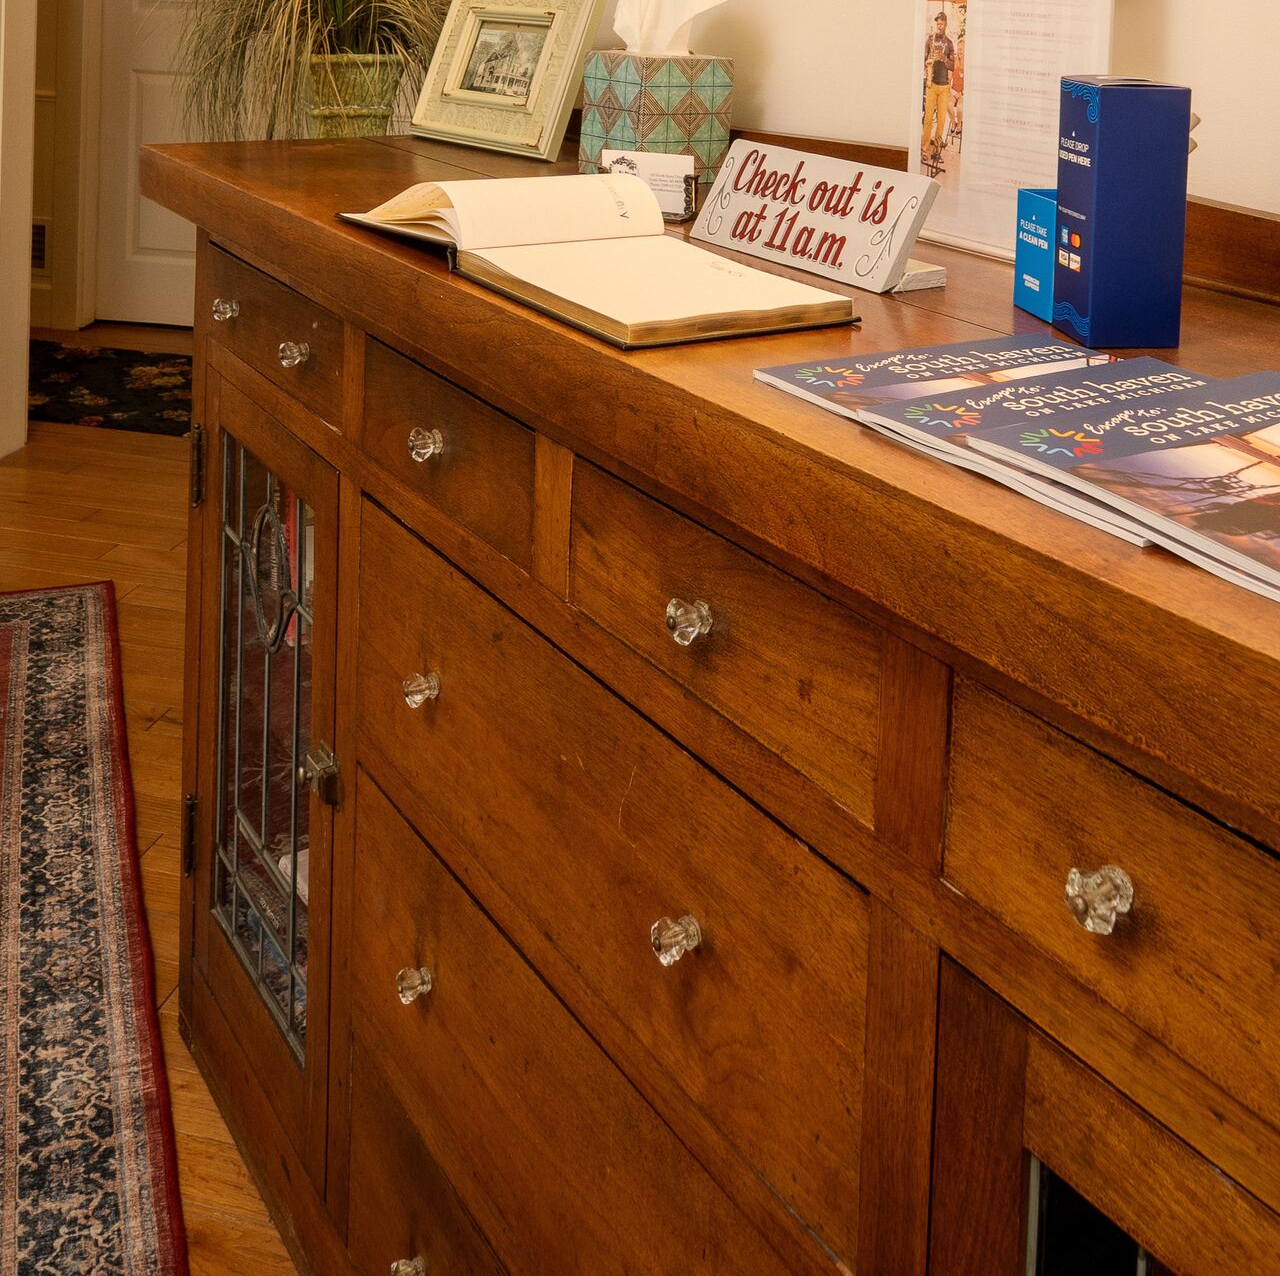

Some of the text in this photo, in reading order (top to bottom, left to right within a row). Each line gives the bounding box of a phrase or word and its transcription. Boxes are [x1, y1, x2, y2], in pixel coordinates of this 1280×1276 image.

[1061, 137, 1090, 153] PLEASE DROP
[1068, 153, 1077, 163] PEN
[1077, 155, 1091, 167] HERE
[733, 149, 895, 225] Check out is
[731, 204, 767, 244] at
[1020, 219, 1036, 233] PLEASE
[1036, 225, 1048, 237] TAKE
[1023, 232, 1038, 246] CLEAN
[1038, 238, 1048, 250] PEN
[855, 353, 933, 372] Escape to:
[888, 345, 1073, 374] south haven
[906, 351, 1087, 379] ON LAKE MICHIGAN
[965, 385, 1047, 410] Escape to:
[1002, 372, 1192, 411] south haven
[1025, 380, 1208, 417] ON LAKE MICHIGAN
[1083, 407, 1168, 435] Escape to:
[1123, 407, 1226, 436] south
[1149, 433, 1182, 444] ON
[1184, 420, 1241, 437] LAKE
